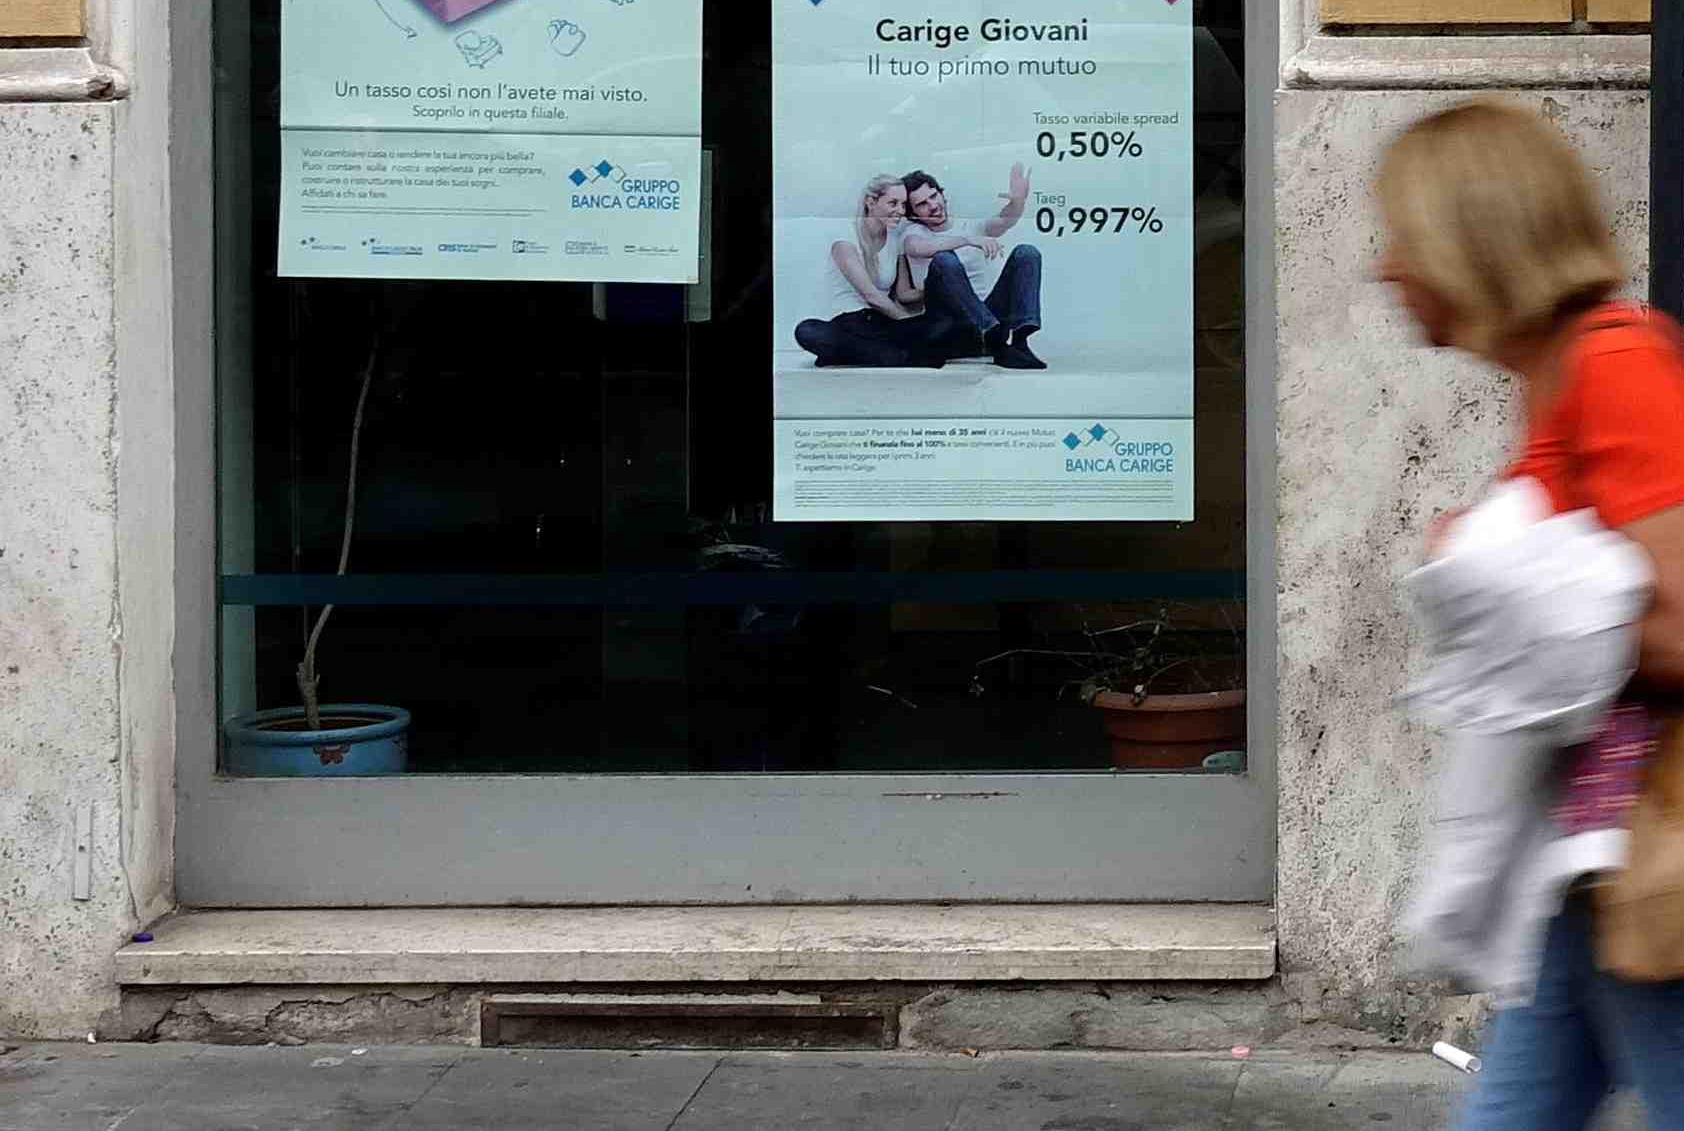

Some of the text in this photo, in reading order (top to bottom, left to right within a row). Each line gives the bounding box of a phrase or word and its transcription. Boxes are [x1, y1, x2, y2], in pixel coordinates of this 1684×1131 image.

[875, 18, 1088, 48] Carige Giovani
[867, 54, 1097, 83] Il tuo primo mutuo
[335, 81, 360, 98] Un
[365, 83, 412, 99] tasso
[457, 86, 492, 100] non
[562, 85, 595, 101] mai
[600, 85, 648, 103] visto.
[413, 104, 465, 120] Scoprilo
[468, 106, 481, 118] in
[484, 108, 528, 122] questa
[1033, 111, 1180, 129] Tasso variabile spread
[1036, 130, 1144, 162] 0,50%
[621, 179, 681, 195] GRUPPO
[571, 194, 681, 211] BANCA CARIGE
[1034, 192, 1066, 208] Taeg
[1036, 205, 1164, 238] 0,997%
[1115, 442, 1174, 457] GRUPPO
[1065, 458, 1174, 473] BANCA CARIGE
